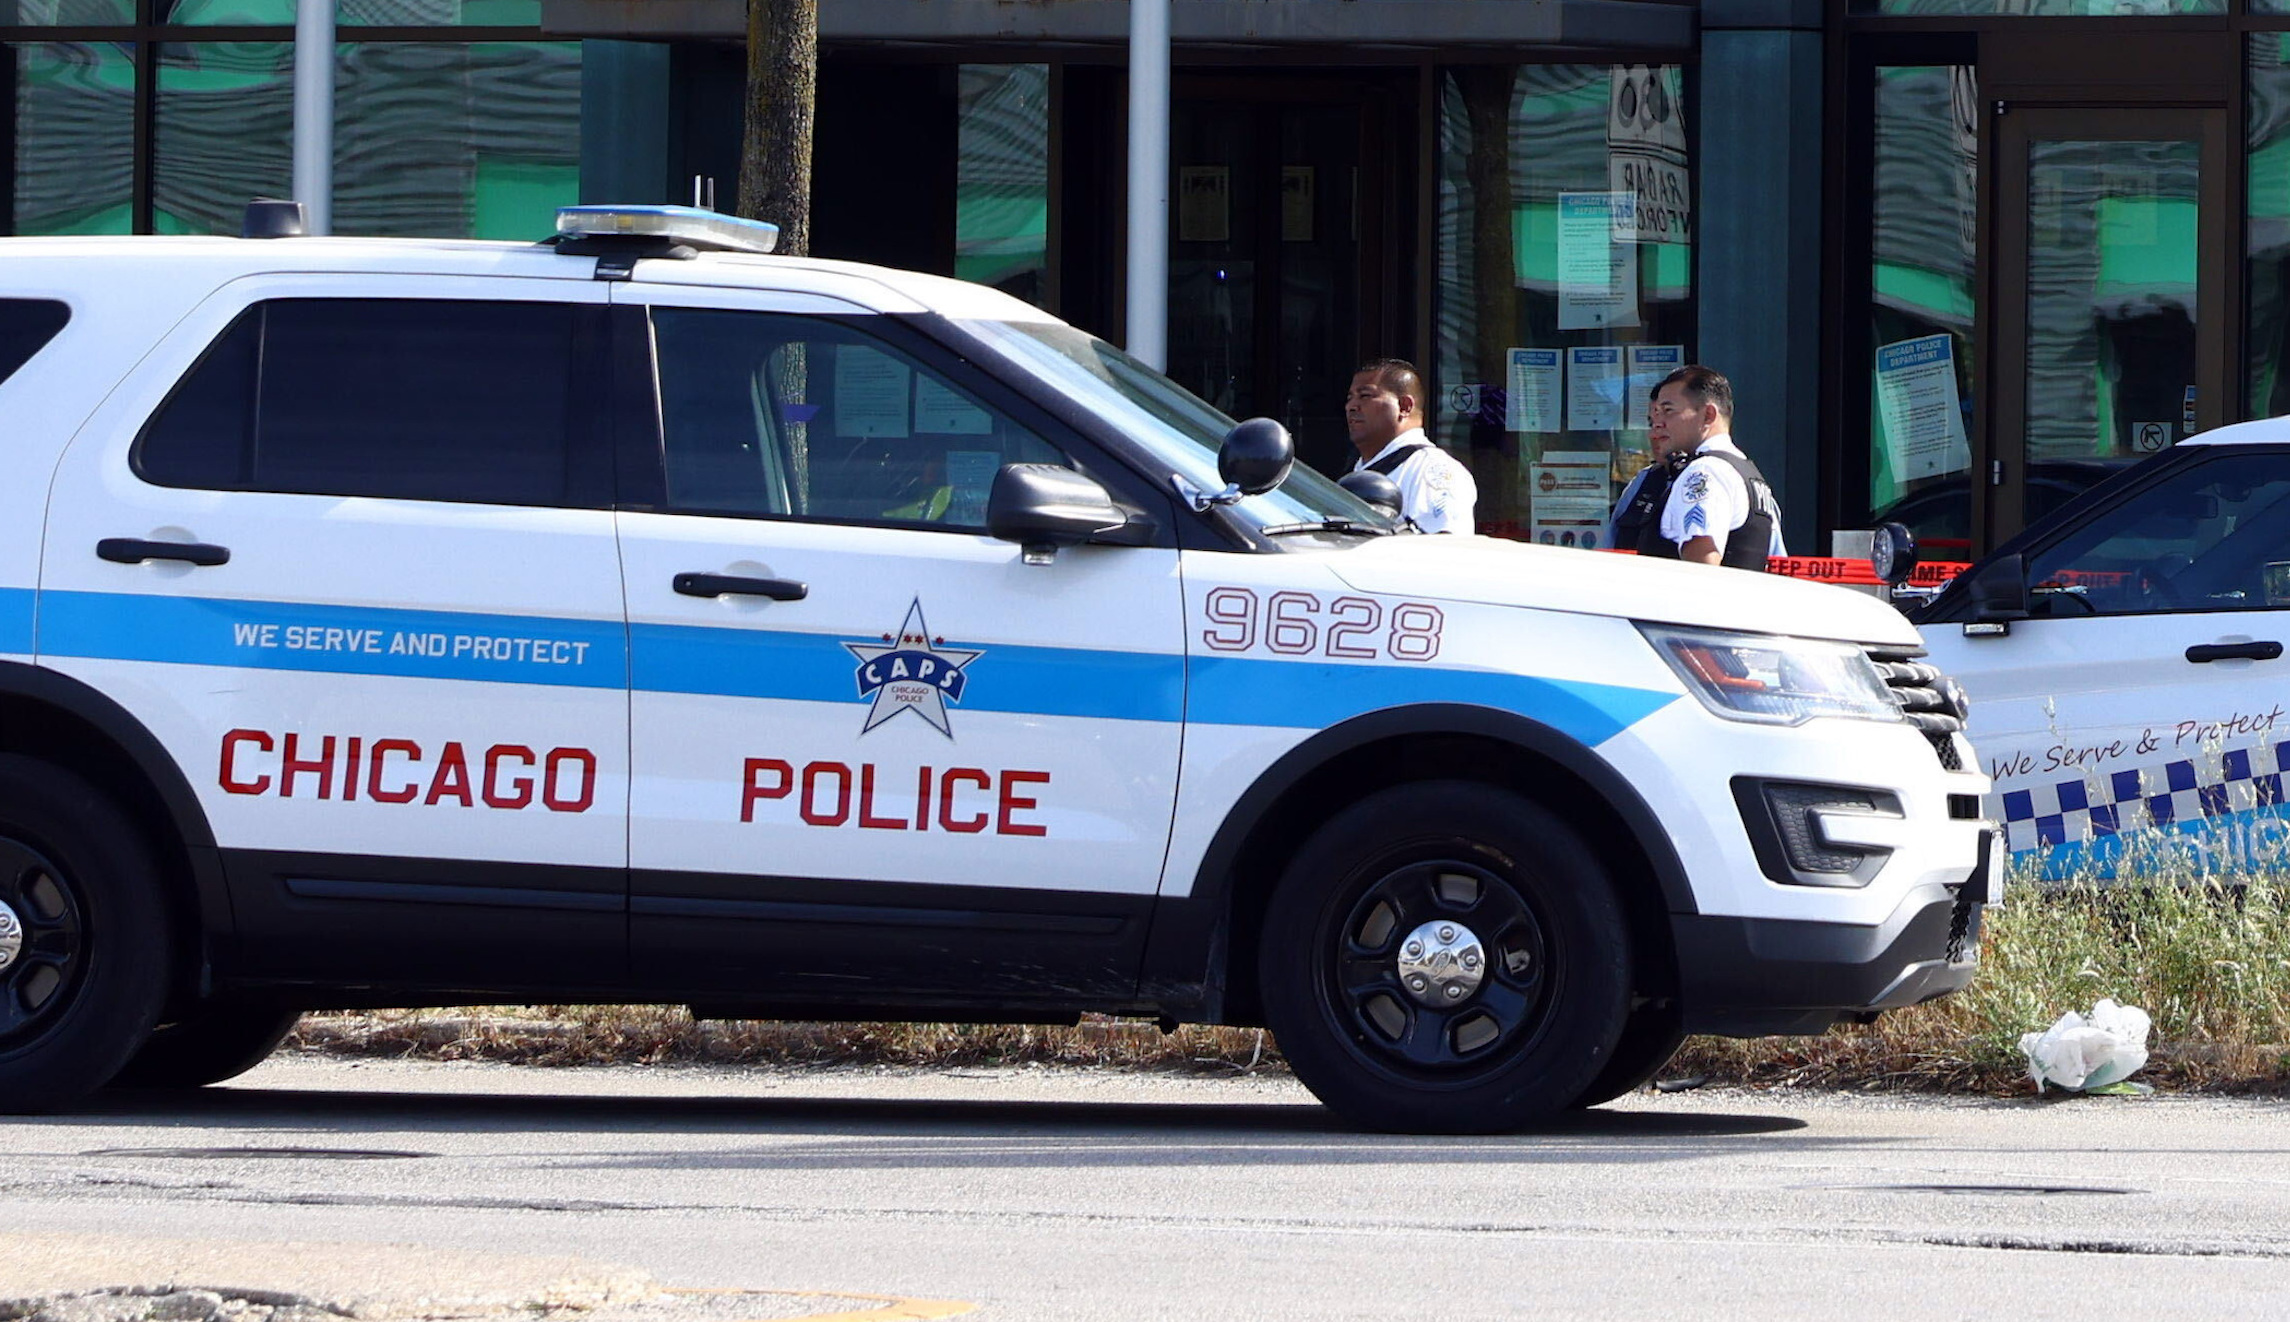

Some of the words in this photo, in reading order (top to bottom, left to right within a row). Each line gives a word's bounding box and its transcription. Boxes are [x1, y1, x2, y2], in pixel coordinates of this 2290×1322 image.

[1767, 559, 1801, 576] EEP
[1808, 560, 1846, 578] OUT
[1203, 586, 1444, 662] 9628
[234, 622, 280, 648] WE
[285, 626, 383, 653] SERVE
[389, 632, 448, 657] AND
[453, 635, 590, 665] PROTECT
[865, 657, 958, 688] CAPS
[891, 686, 929, 695] CHICAGO
[895, 695, 923, 703] POLICE
[1991, 750, 2038, 782] We
[2043, 738, 2129, 772] Serve
[2136, 729, 2161, 755] &
[2174, 704, 2285, 746] Protect
[218, 728, 597, 813] CHICAGO
[740, 757, 1050, 837] POLICE
